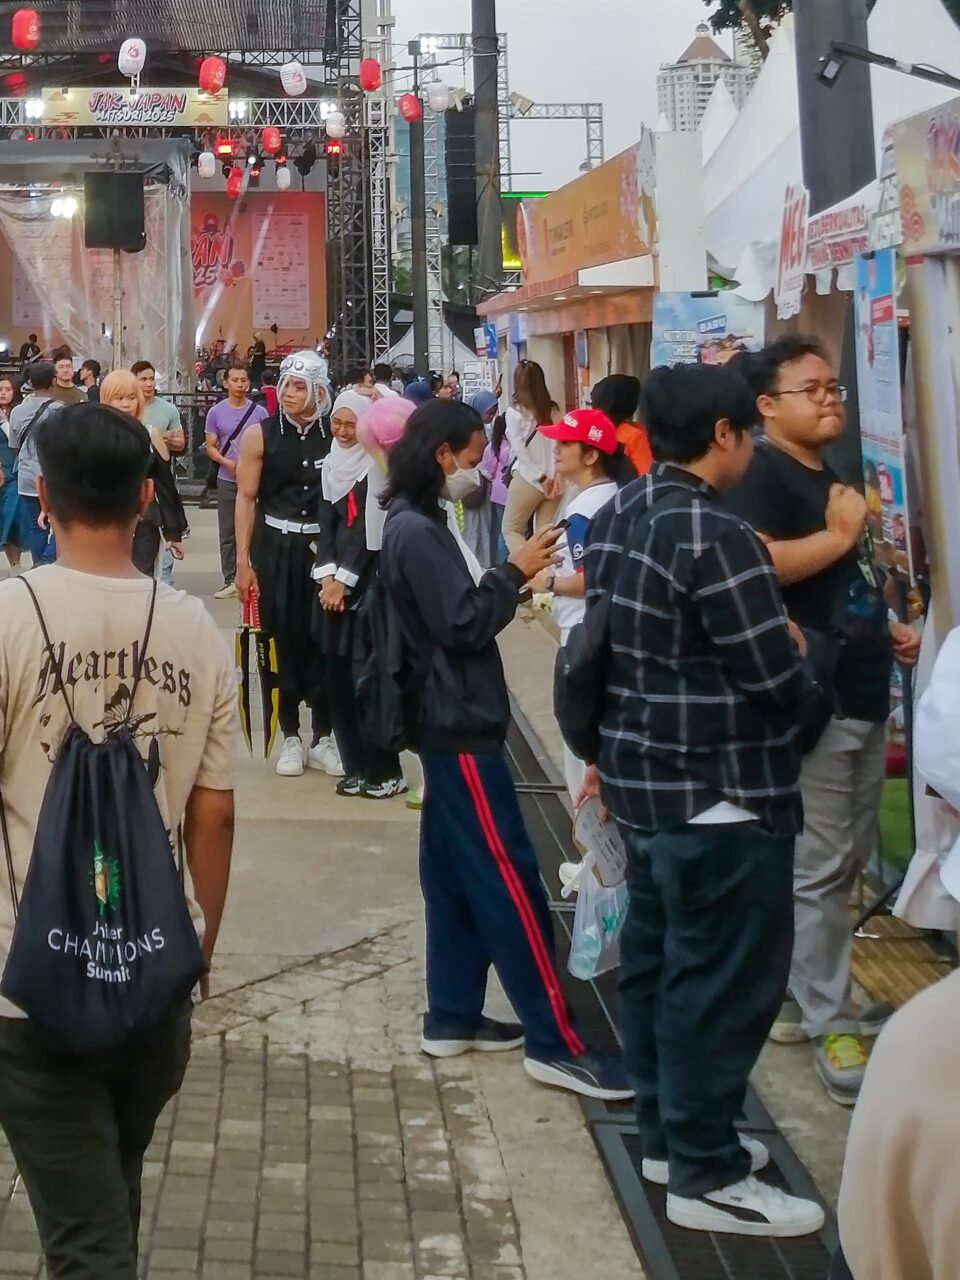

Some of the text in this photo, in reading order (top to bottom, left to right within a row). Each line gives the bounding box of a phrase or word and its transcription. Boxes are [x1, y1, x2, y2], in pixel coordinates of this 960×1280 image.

[89, 91, 187, 114] JAK-JAPAN
[95, 107, 177, 122] MATSURI 2025
[192, 267, 218, 287] 25
[699, 316, 726, 334] BARU
[31, 640, 192, 708] Heartless
[47, 927, 165, 966] CHAMPIONS
